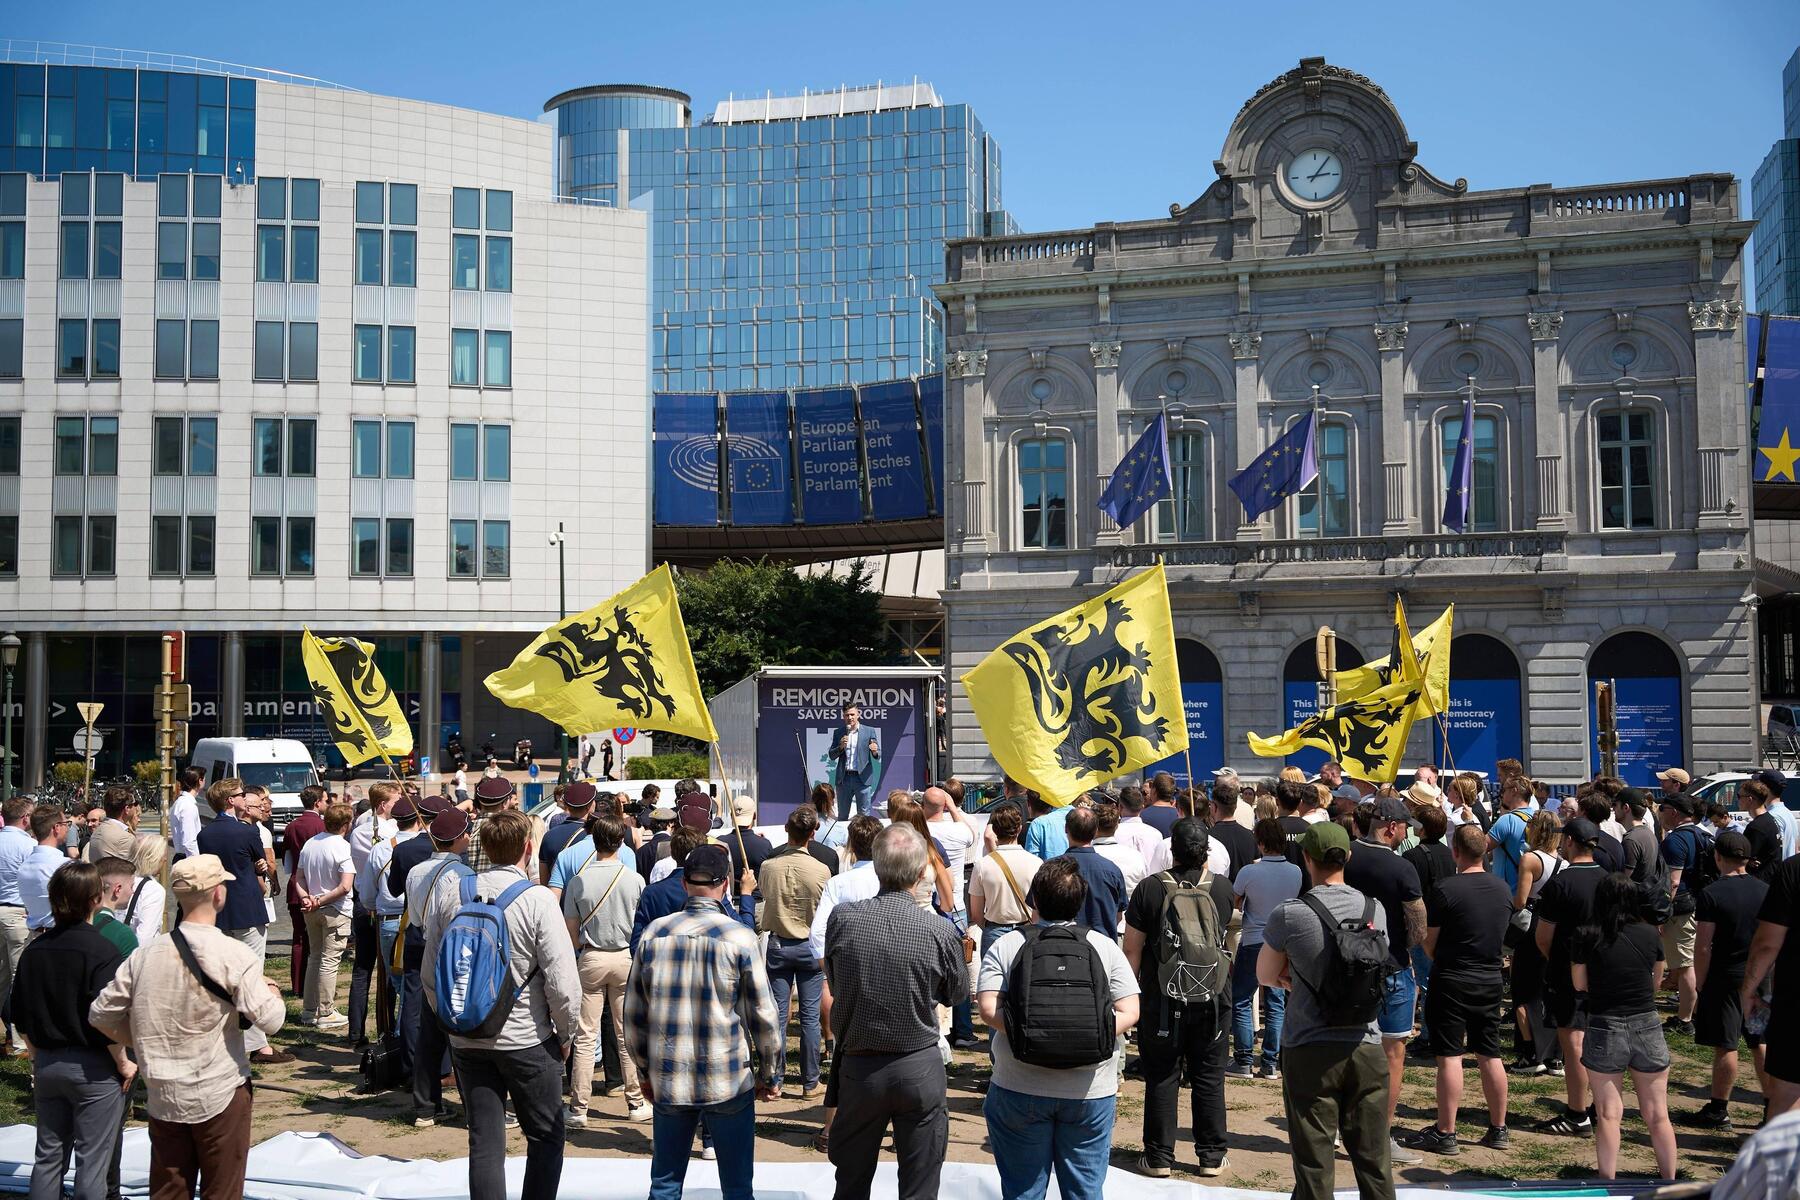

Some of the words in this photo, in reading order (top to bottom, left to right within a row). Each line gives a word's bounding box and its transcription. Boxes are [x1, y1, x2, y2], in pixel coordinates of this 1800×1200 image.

[800, 418, 880, 436] European
[802, 433, 892, 453] Parliament
[803, 453, 912, 475] Europäisches
[805, 473, 893, 492] Parlament
[772, 688, 914, 707] REMIGRATION
[1293, 699, 1312, 707] This
[1448, 699, 1462, 707] his
[1464, 698, 1472, 707] is
[797, 708, 837, 720] SAVES
[840, 708, 888, 720] ROPE
[1453, 720, 1487, 728] action.
